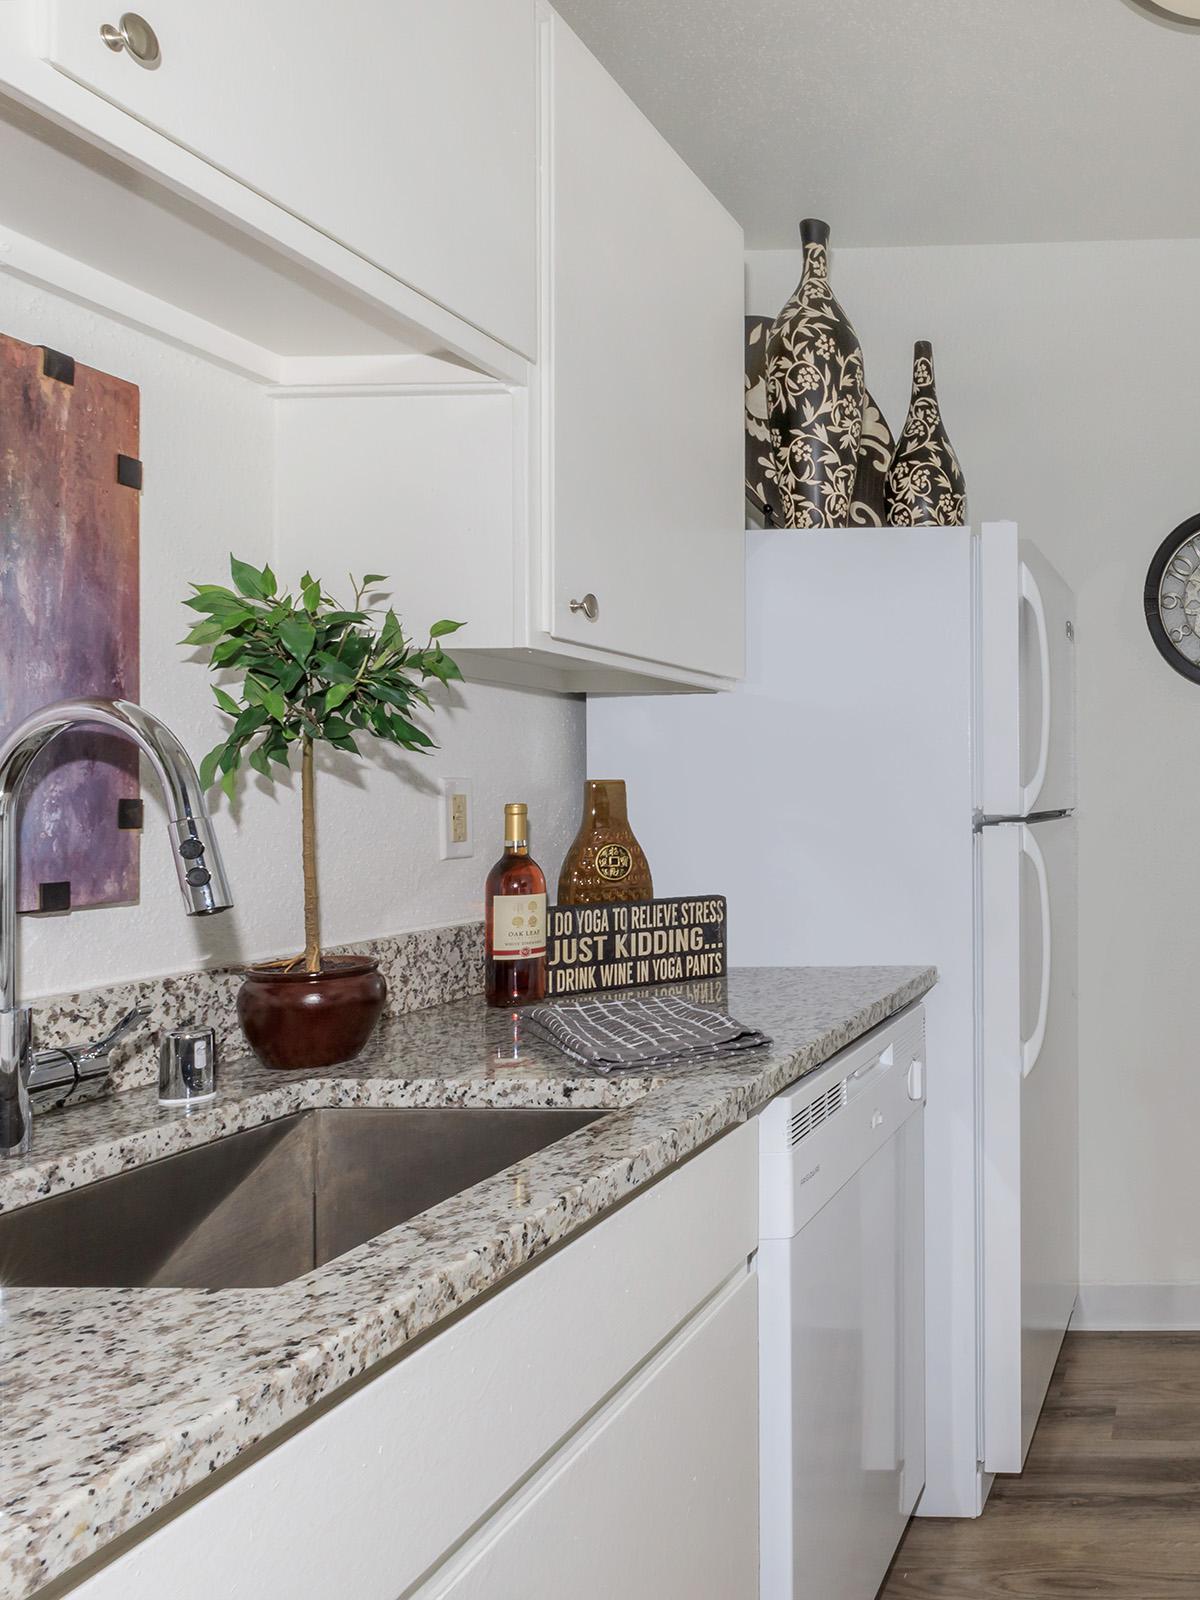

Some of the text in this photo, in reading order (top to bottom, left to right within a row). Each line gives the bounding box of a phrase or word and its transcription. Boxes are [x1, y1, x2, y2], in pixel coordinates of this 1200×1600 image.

[1165, 554, 1194, 585] 10
[1160, 592, 1185, 610] 9
[1169, 624, 1194, 644] 8
[547, 900, 724, 937] I DO YOGA TO RELIEVE STRESS
[548, 926, 723, 966] JUST KIDDING...
[549, 970, 553, 994] I
[556, 966, 597, 993] DRINK
[600, 962, 634, 987] WINE
[636, 959, 649, 983] IN
[652, 955, 683, 981] YOGA
[685, 952, 722, 977] PANTS
